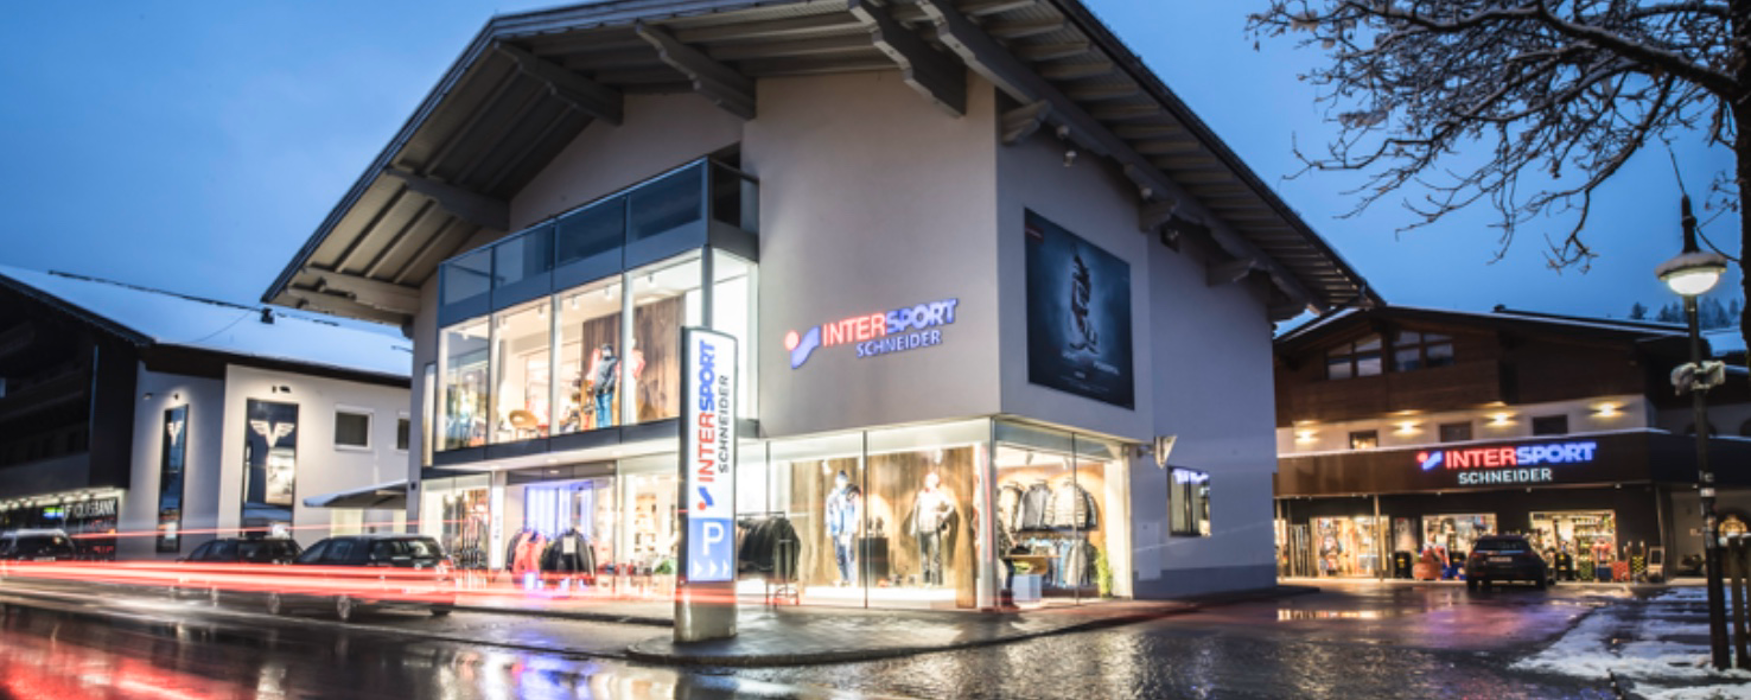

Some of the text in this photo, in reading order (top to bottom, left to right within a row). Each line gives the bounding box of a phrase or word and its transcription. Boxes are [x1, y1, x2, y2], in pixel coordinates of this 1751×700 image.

[823, 299, 957, 346] INTERSPORT
[857, 330, 942, 357] SCHNEIDER
[698, 340, 715, 482] INTERSPORT
[718, 375, 729, 473] SCHNEIDER
[1445, 442, 1597, 469] INTERSPORT
[1458, 468, 1553, 485] SCHNEIDER
[703, 522, 724, 556] P
